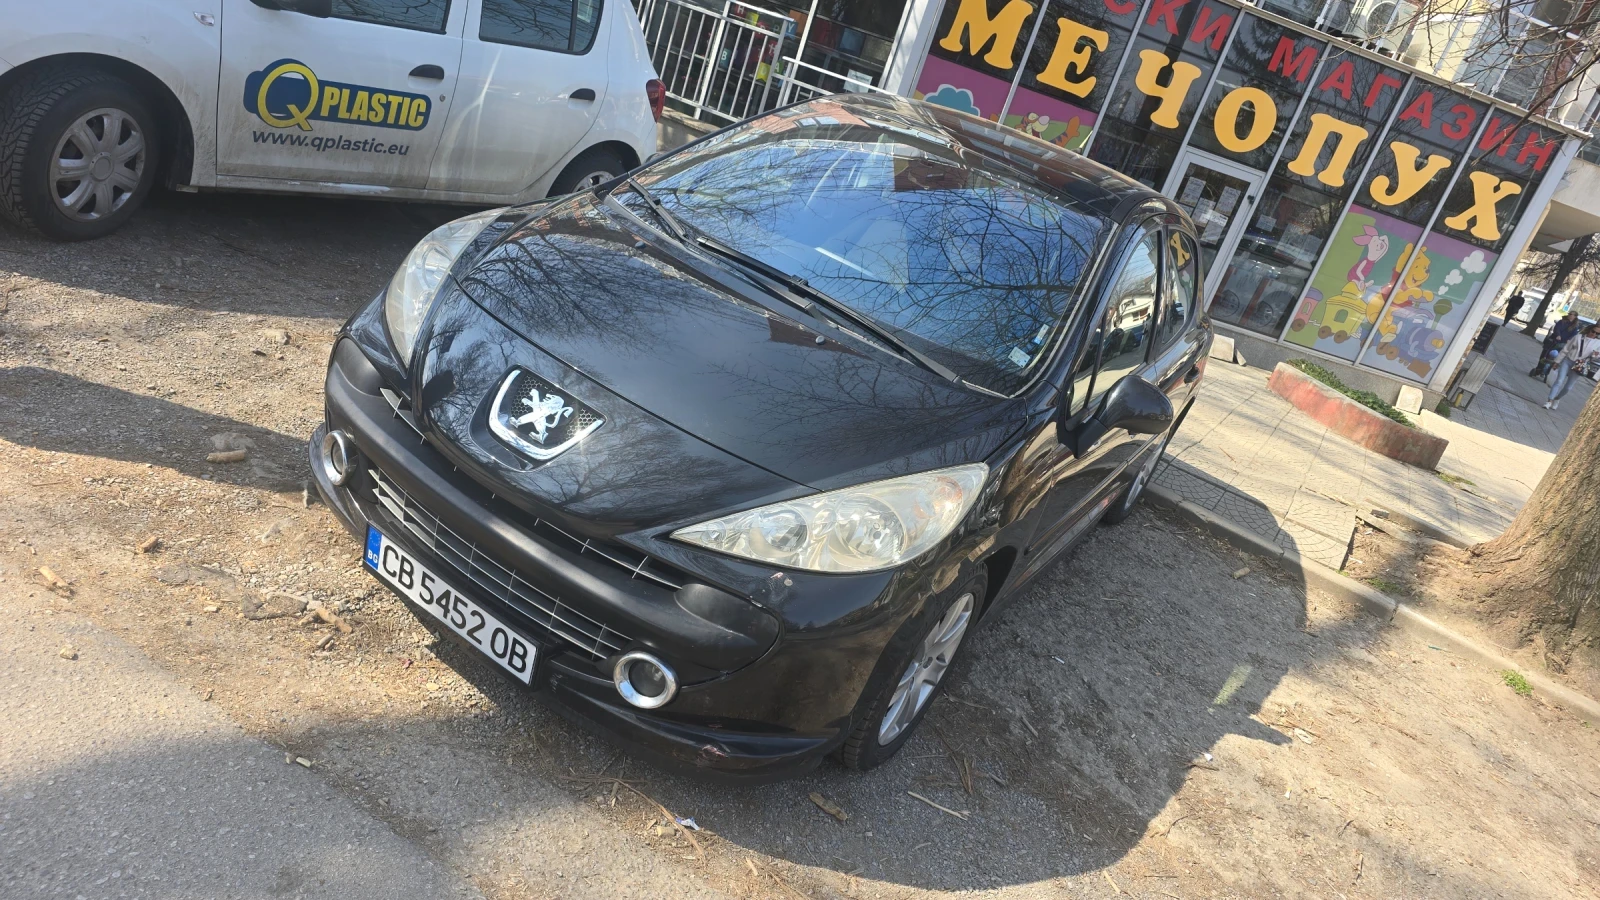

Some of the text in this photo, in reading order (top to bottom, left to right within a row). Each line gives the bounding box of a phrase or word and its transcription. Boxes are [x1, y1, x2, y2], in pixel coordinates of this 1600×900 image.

[252, 130, 410, 156] www.qplastic.eu
[939, 0, 1522, 240] МЕЧОПУХ
[1267, 36, 1558, 171] МАГАЗИН
[367, 549, 378, 564] BG
[382, 544, 415, 590] CB
[419, 571, 486, 645] 5452
